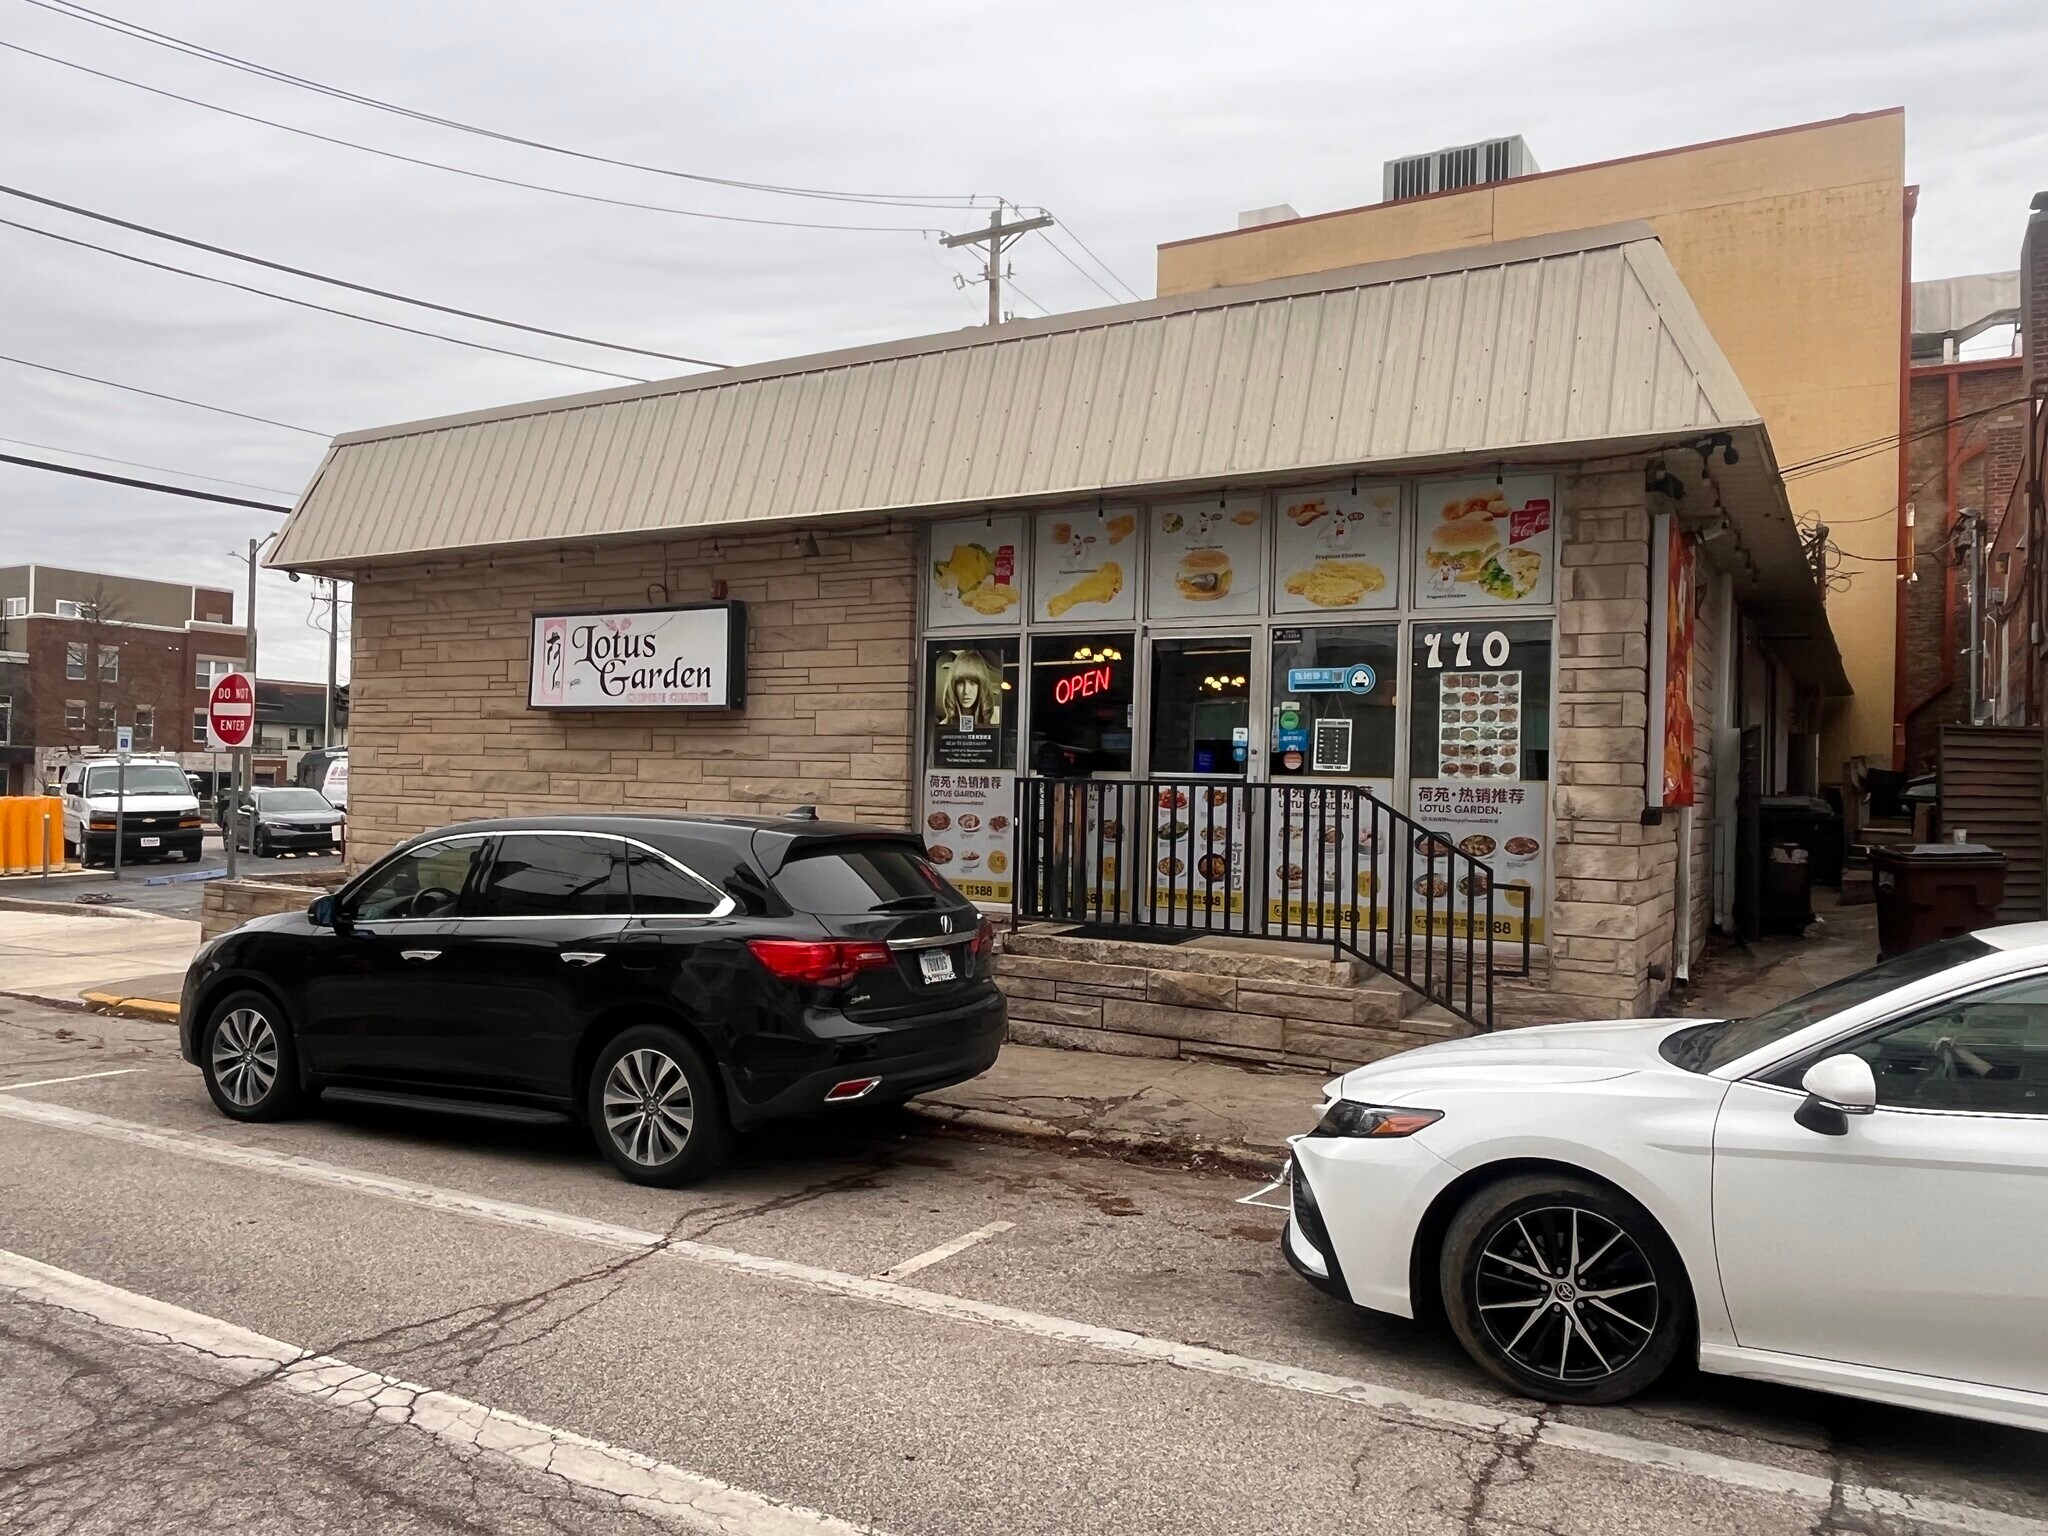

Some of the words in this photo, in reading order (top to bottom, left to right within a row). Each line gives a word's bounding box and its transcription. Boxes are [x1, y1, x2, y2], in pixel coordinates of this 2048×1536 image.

[572, 625, 657, 666] Lotus
[1424, 630, 1510, 668] 110
[599, 656, 712, 697] Garden
[1055, 666, 1110, 704] OPEN
[218, 687, 230, 699] DO
[235, 688, 250, 699] NOT
[220, 719, 245, 731] ENTER
[930, 789, 953, 798] LOTUS
[1419, 803, 1452, 813] LOTUS
[1454, 805, 1503, 815] GARDEN.
